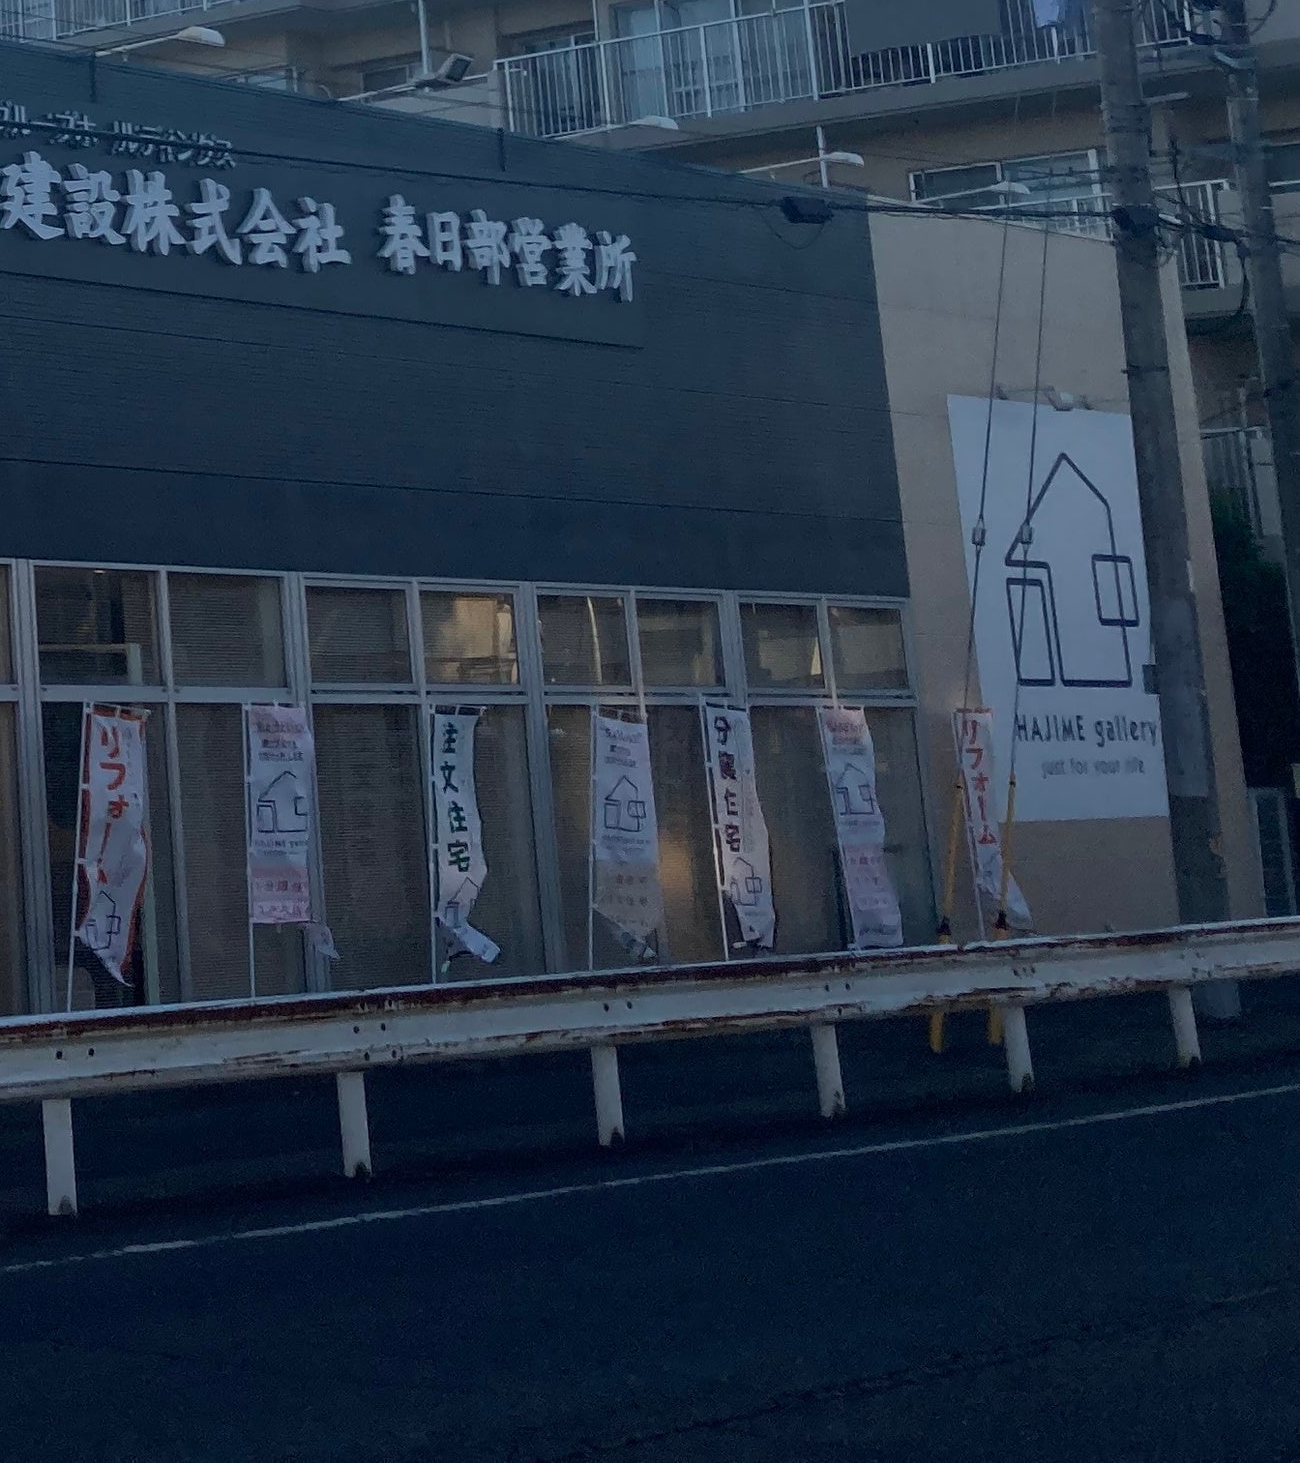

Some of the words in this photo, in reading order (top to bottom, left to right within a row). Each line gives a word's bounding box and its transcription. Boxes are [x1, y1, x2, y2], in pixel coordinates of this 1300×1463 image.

[379, 194, 637, 303] 春日部営業所
[1015, 712, 1086, 743] HAJIME
[1094, 713, 1158, 748] gallery
